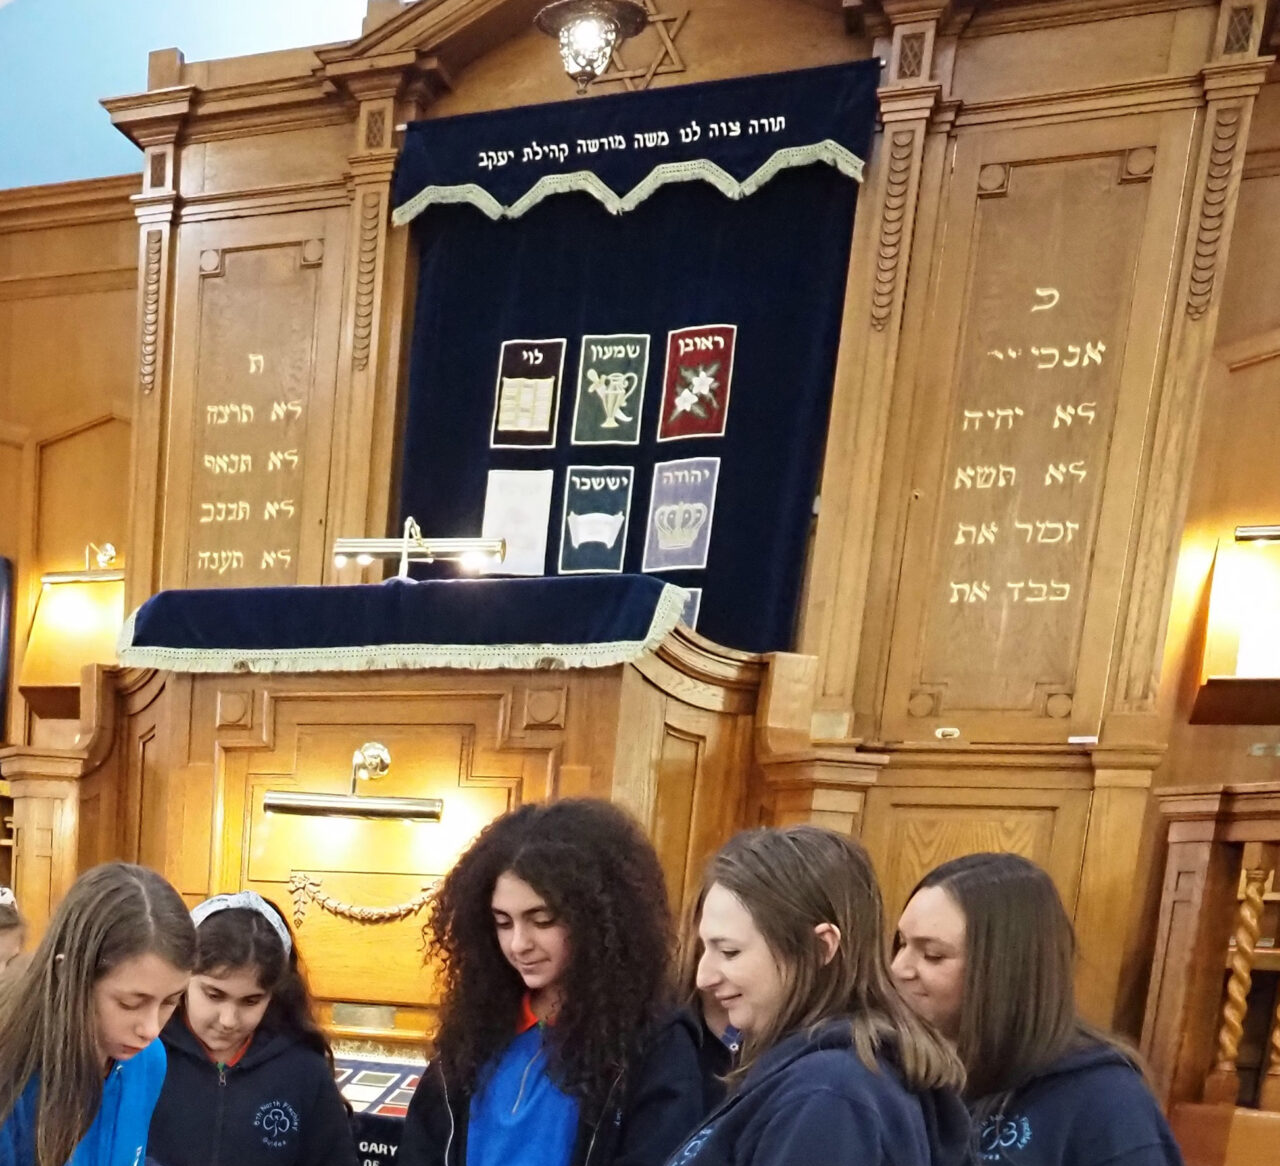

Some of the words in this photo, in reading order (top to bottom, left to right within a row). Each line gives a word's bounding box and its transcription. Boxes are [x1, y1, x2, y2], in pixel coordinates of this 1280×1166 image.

[679, 120, 701, 143] לנו
[708, 121, 742, 138] צוה
[748, 116, 786, 135] תורה
[576, 134, 627, 154] מורשה
[633, 130, 670, 149] משה
[478, 150, 515, 171] יעקב
[522, 140, 569, 163] קהילת
[522, 348, 544, 365] לוי
[590, 343, 641, 363] שמעון
[677, 335, 725, 357] ראובן
[1030, 340, 1106, 370] אנכי
[206, 402, 254, 425] תרצה
[270, 399, 303, 422] לא
[1052, 401, 1097, 429] לא
[203, 453, 252, 475] תנאף
[267, 448, 299, 472] לא
[571, 475, 631, 493] יששכר
[662, 469, 710, 486] יהודה
[953, 463, 1017, 490] תשא
[1044, 460, 1088, 486] לא
[263, 499, 295, 521] לא
[953, 521, 999, 546] את
[197, 549, 244, 575] תענה
[260, 548, 292, 570] לא
[949, 580, 991, 604] את
[1003, 578, 1071, 605] כבד
